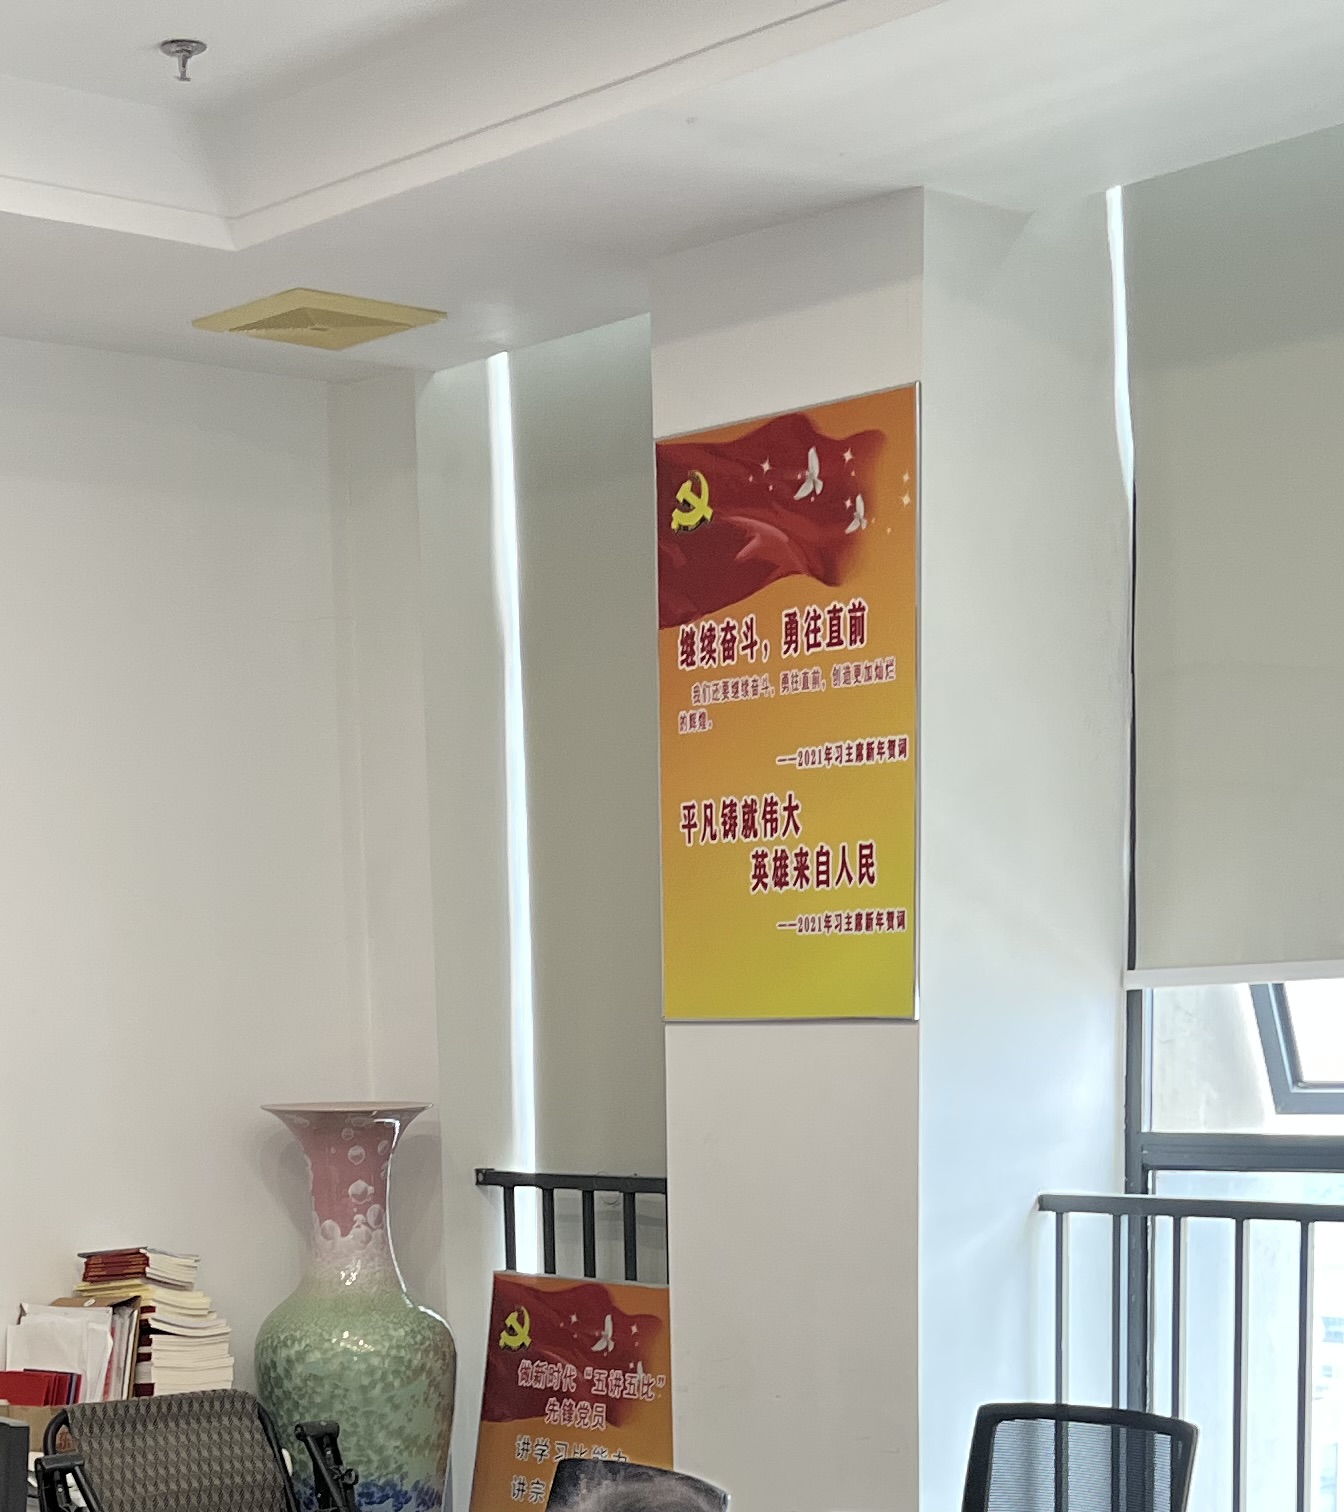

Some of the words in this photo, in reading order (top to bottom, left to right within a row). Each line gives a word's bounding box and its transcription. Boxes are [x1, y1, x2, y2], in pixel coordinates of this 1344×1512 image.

[678, 600, 867, 668] 继续奋斗，勇往直前
[681, 793, 801, 844] 平凡铸就伟大
[751, 842, 876, 893] 英雄来自人民
[545, 1397, 607, 1431] 先锋党员
